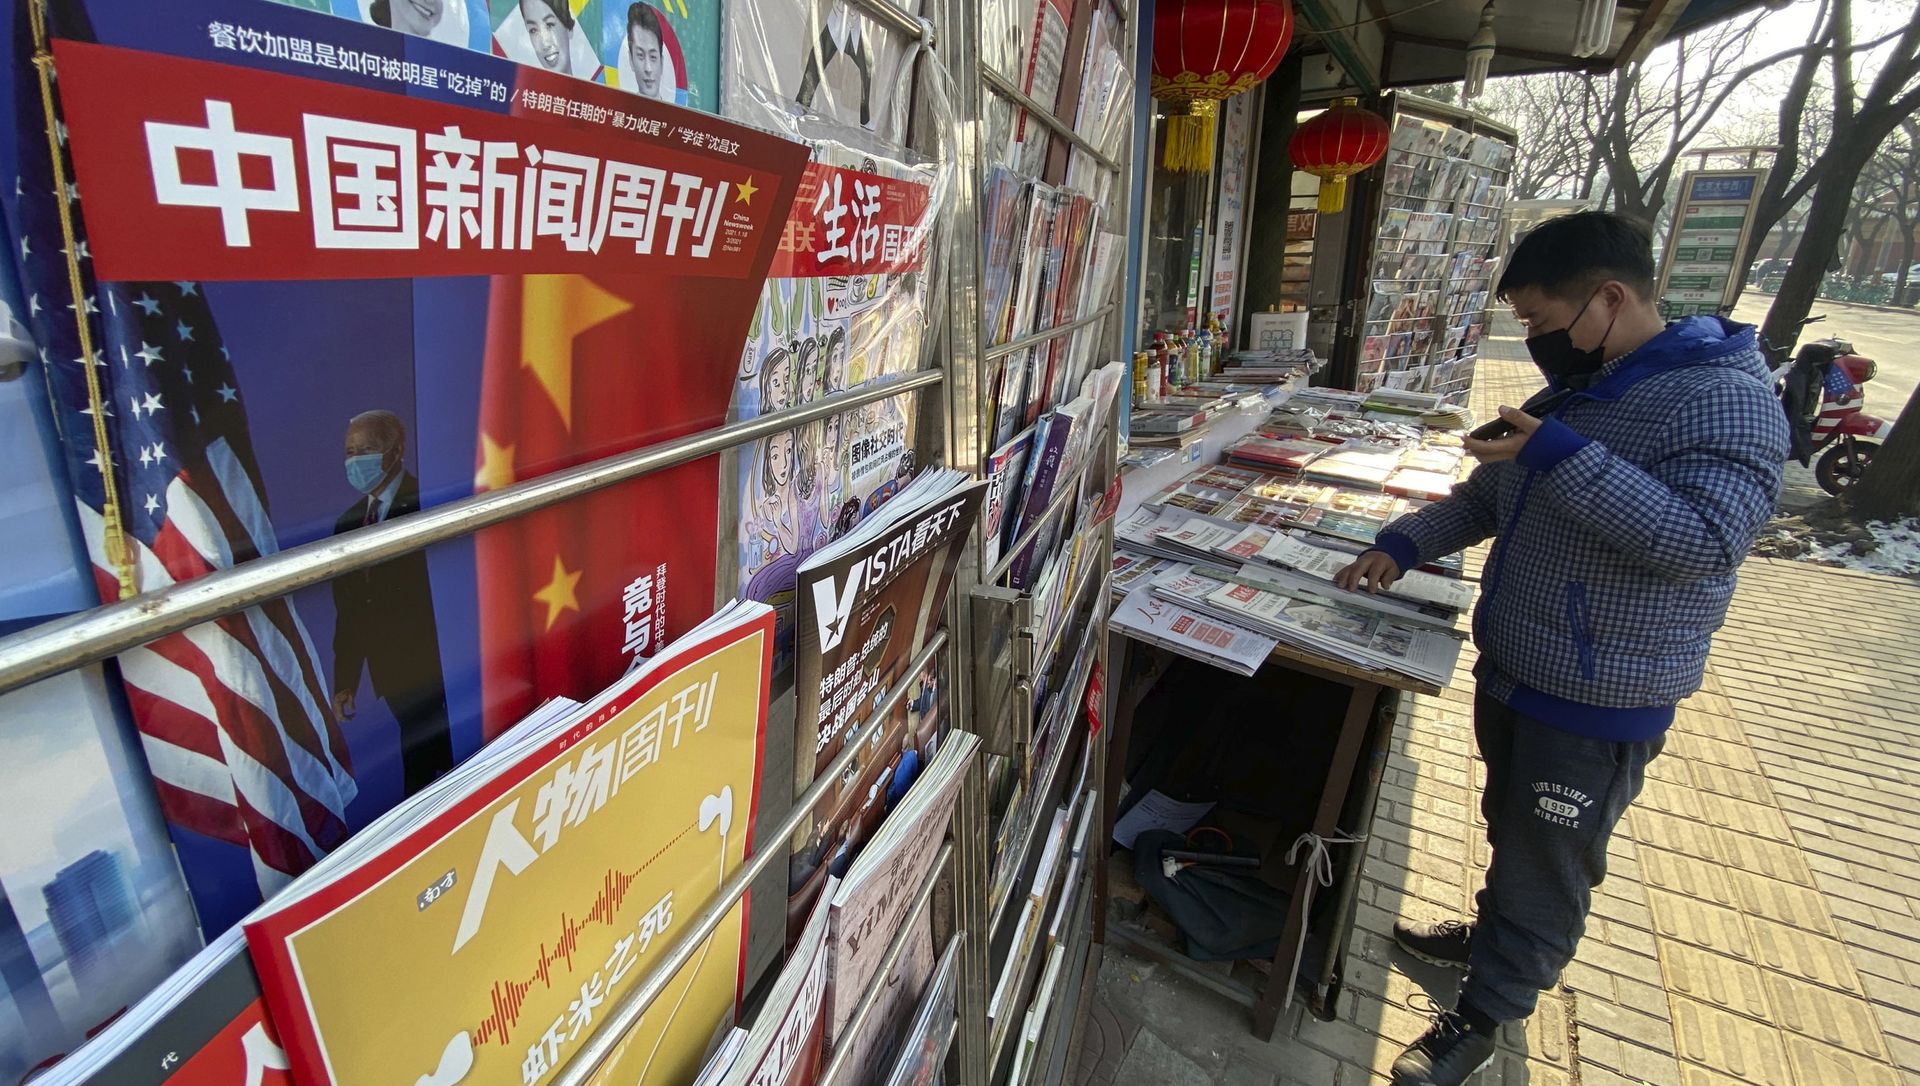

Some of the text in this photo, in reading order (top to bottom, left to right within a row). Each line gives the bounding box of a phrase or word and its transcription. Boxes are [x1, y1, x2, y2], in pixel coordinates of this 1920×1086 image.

[207, 20, 507, 103] 餐饮加盟是如何被明星“吃掉”的
[521, 89, 668, 137] 特朗普任期的“暴力收尾”
[677, 127, 741, 156] “学徒”沈昌文
[144, 99, 731, 259] 中国新闻周刊
[723, 220, 754, 231] Newsweek
[732, 213, 750, 222] China
[851, 421, 904, 464] 图像社交时代
[816, 668, 880, 755] 决战国会山
[818, 665, 864, 724] 最后时刻
[558, 705, 618, 750] 时代的肖像
[450, 671, 720, 956] 人物周刊
[1531, 782, 1594, 808] LIFE IS LIKE A
[1543, 799, 1575, 816] 1997
[1533, 807, 1580, 829] MIRACLE
[520, 890, 674, 1085] 虾米之死
